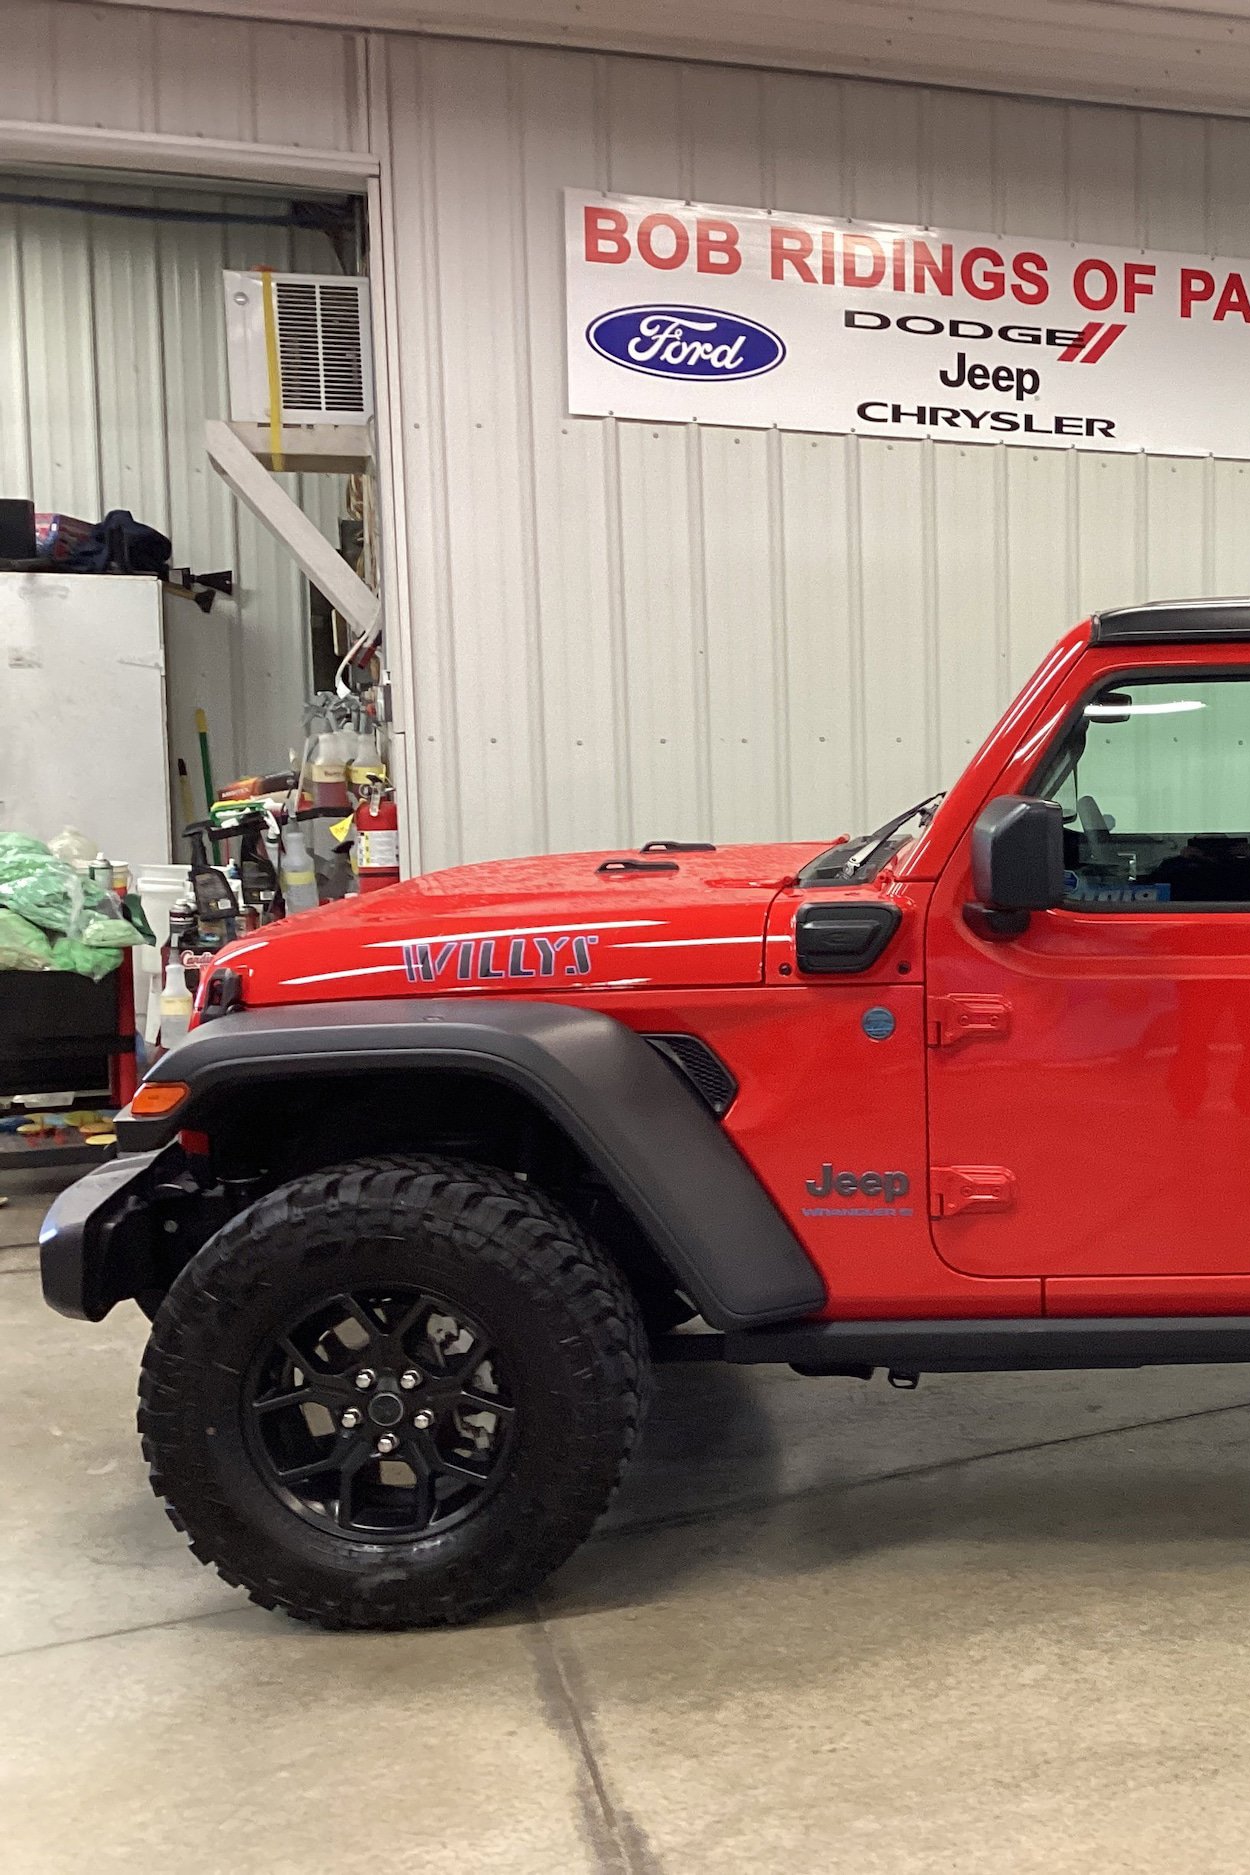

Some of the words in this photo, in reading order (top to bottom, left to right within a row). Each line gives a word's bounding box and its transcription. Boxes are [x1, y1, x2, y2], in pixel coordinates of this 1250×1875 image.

[584, 206, 742, 275] BOB
[770, 226, 1049, 306] RIDINGS
[1073, 258, 1156, 314] OF
[627, 314, 746, 370] Ford
[844, 309, 1086, 349] DODGE
[939, 352, 1040, 402] Jeep
[857, 402, 1116, 439] CHRYSLER
[402, 935, 599, 983] WILLYS
[805, 1162, 909, 1203] Jeep
